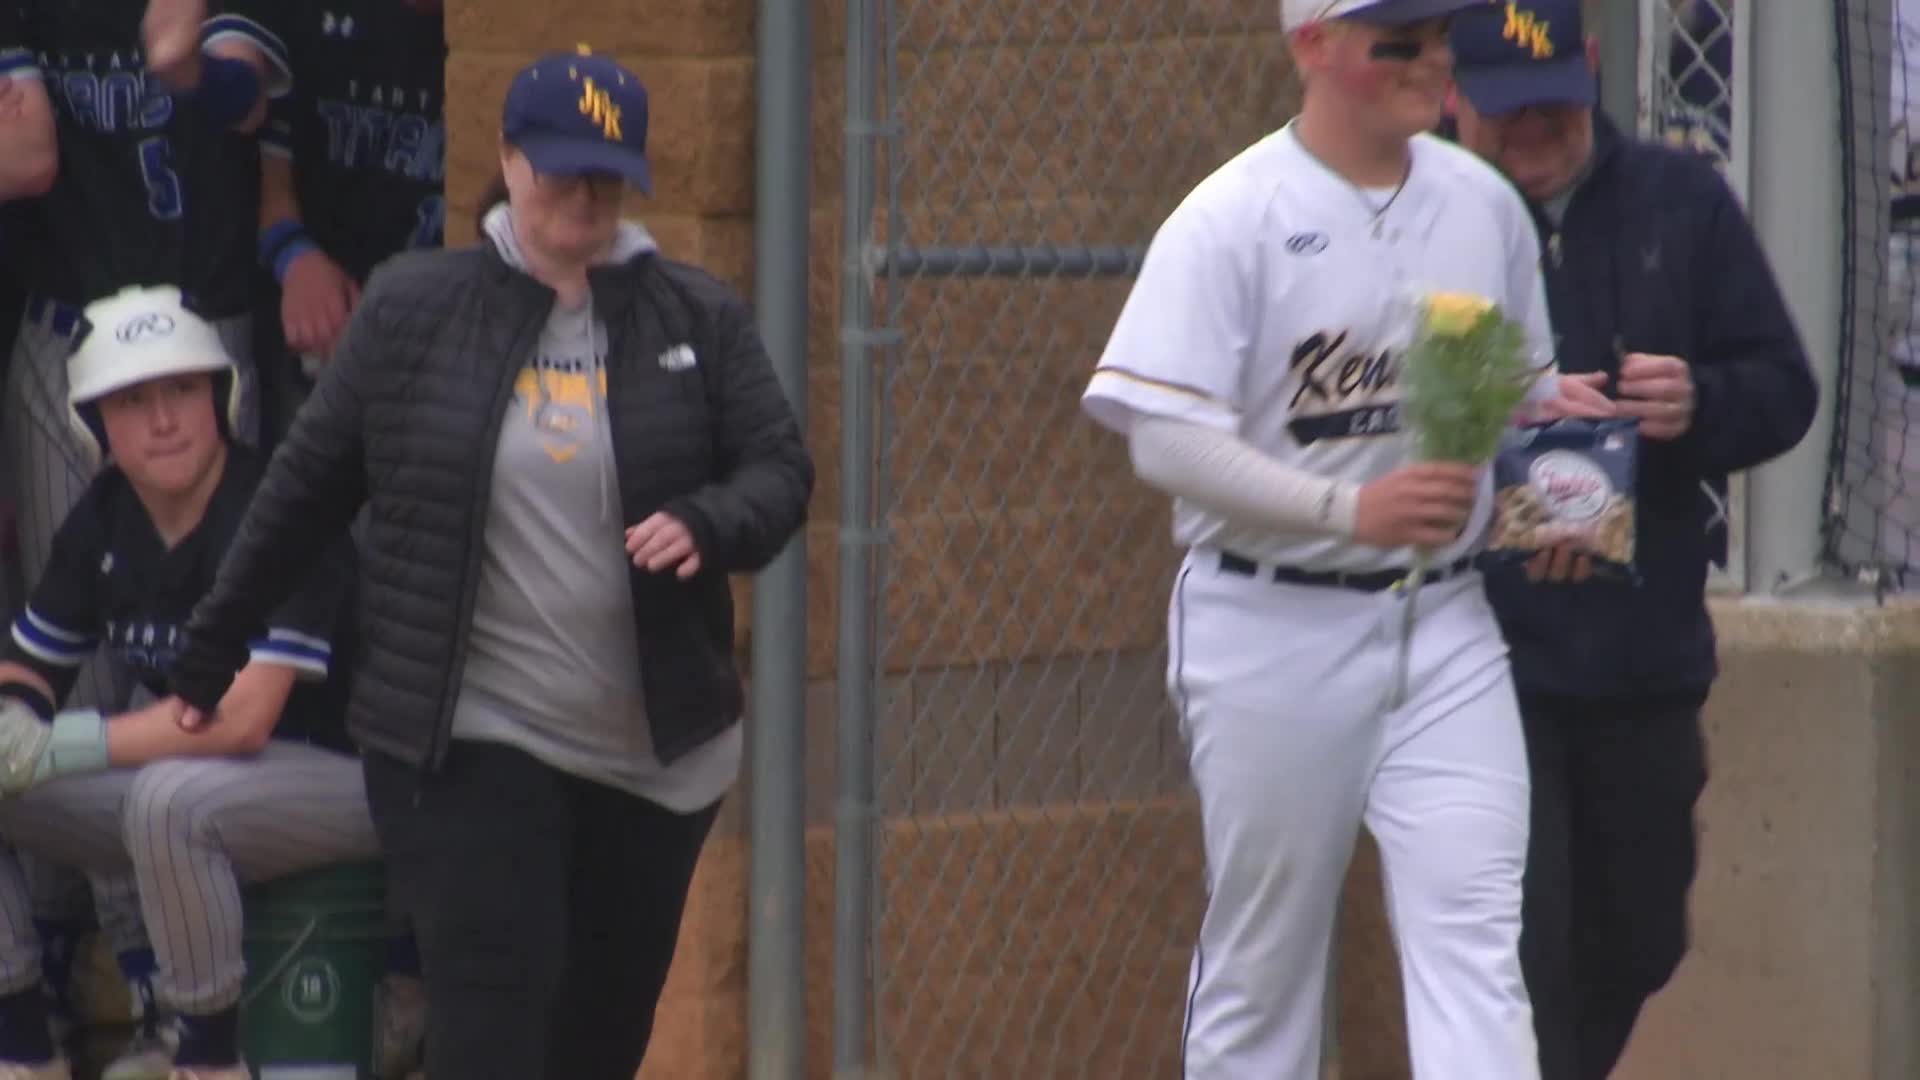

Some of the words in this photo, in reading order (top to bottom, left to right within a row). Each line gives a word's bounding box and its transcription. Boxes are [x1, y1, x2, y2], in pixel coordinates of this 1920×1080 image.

[349, 79, 429, 111] TART
[138, 135, 183, 219] 5
[1287, 328, 1404, 410] Ken
